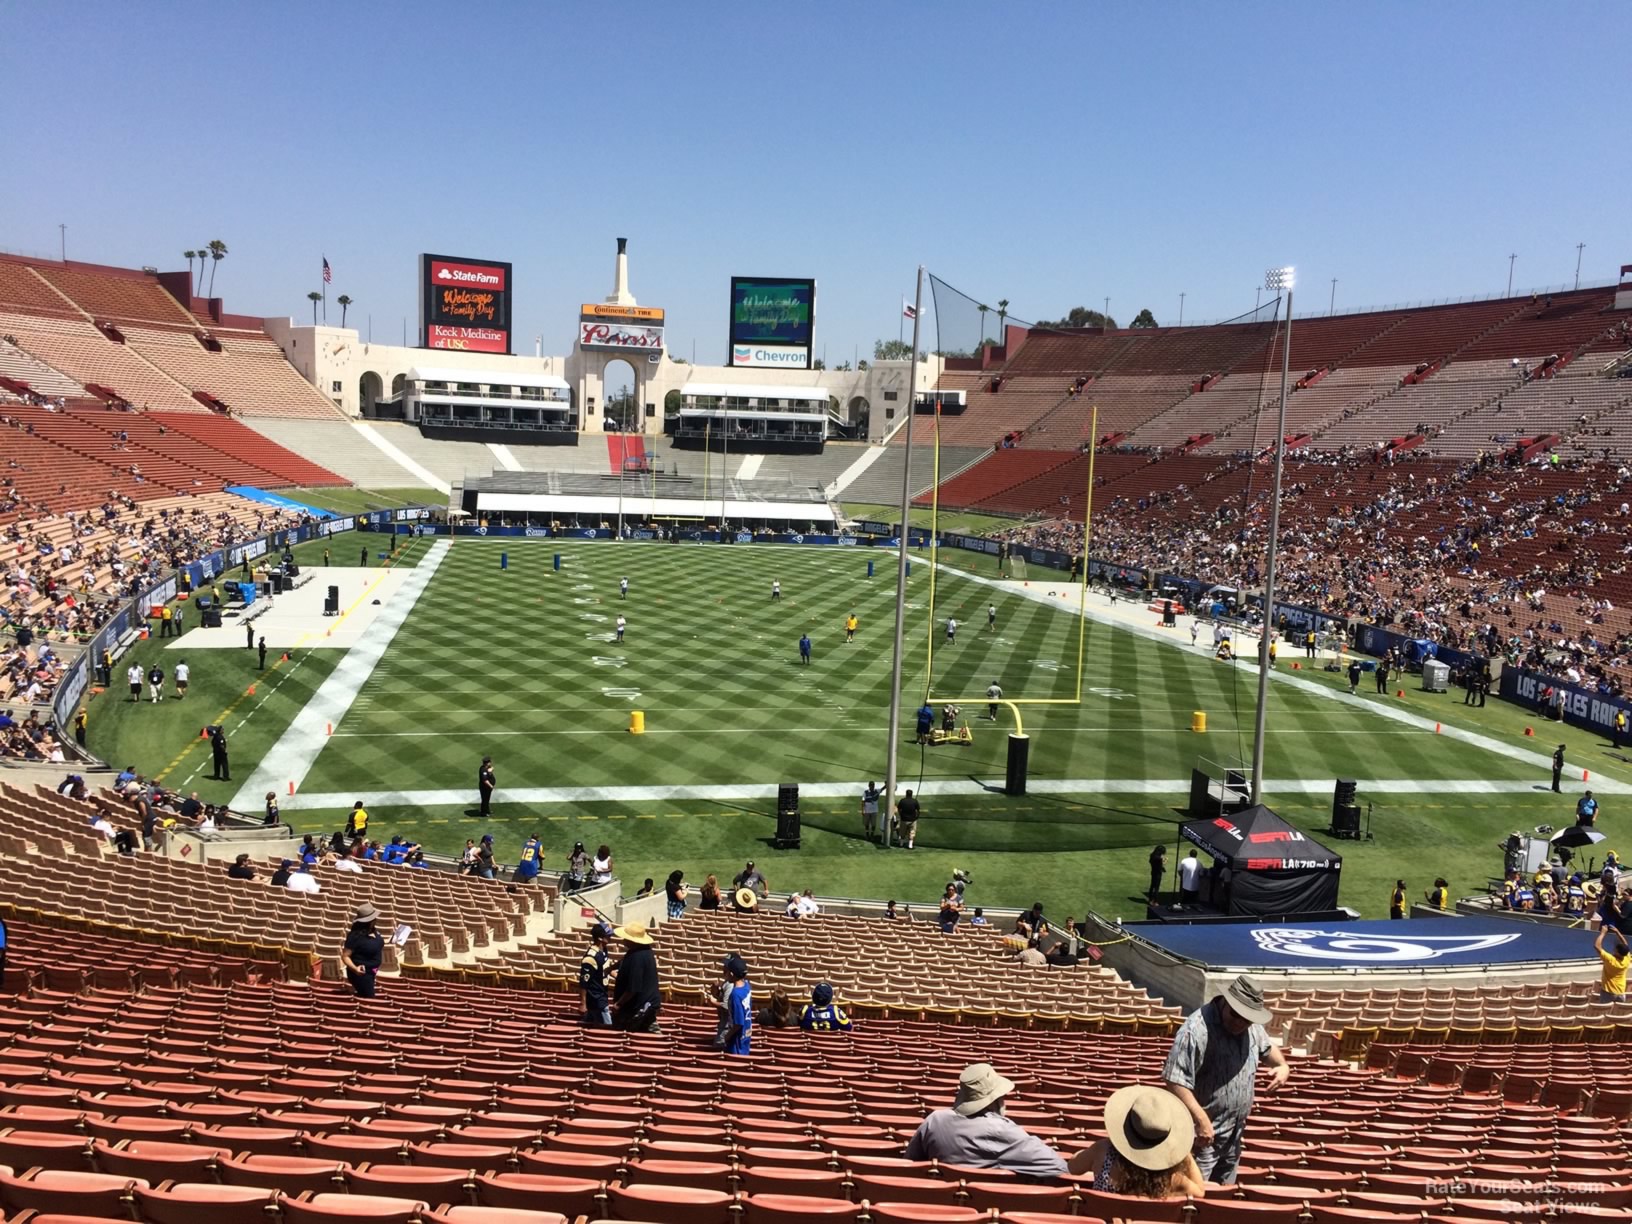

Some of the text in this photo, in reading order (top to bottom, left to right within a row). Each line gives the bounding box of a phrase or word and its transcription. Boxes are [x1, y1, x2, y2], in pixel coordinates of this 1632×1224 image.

[443, 288, 494, 304] Welcome
[477, 303, 495, 321] Day
[435, 325, 502, 341] Keck Medicine
[434, 338, 469, 350] of USC
[755, 349, 807, 362] Chevron
[1516, 675, 1537, 699] LOS
[521, 847, 535, 861] 12
[1301, 860, 1316, 869] 710
